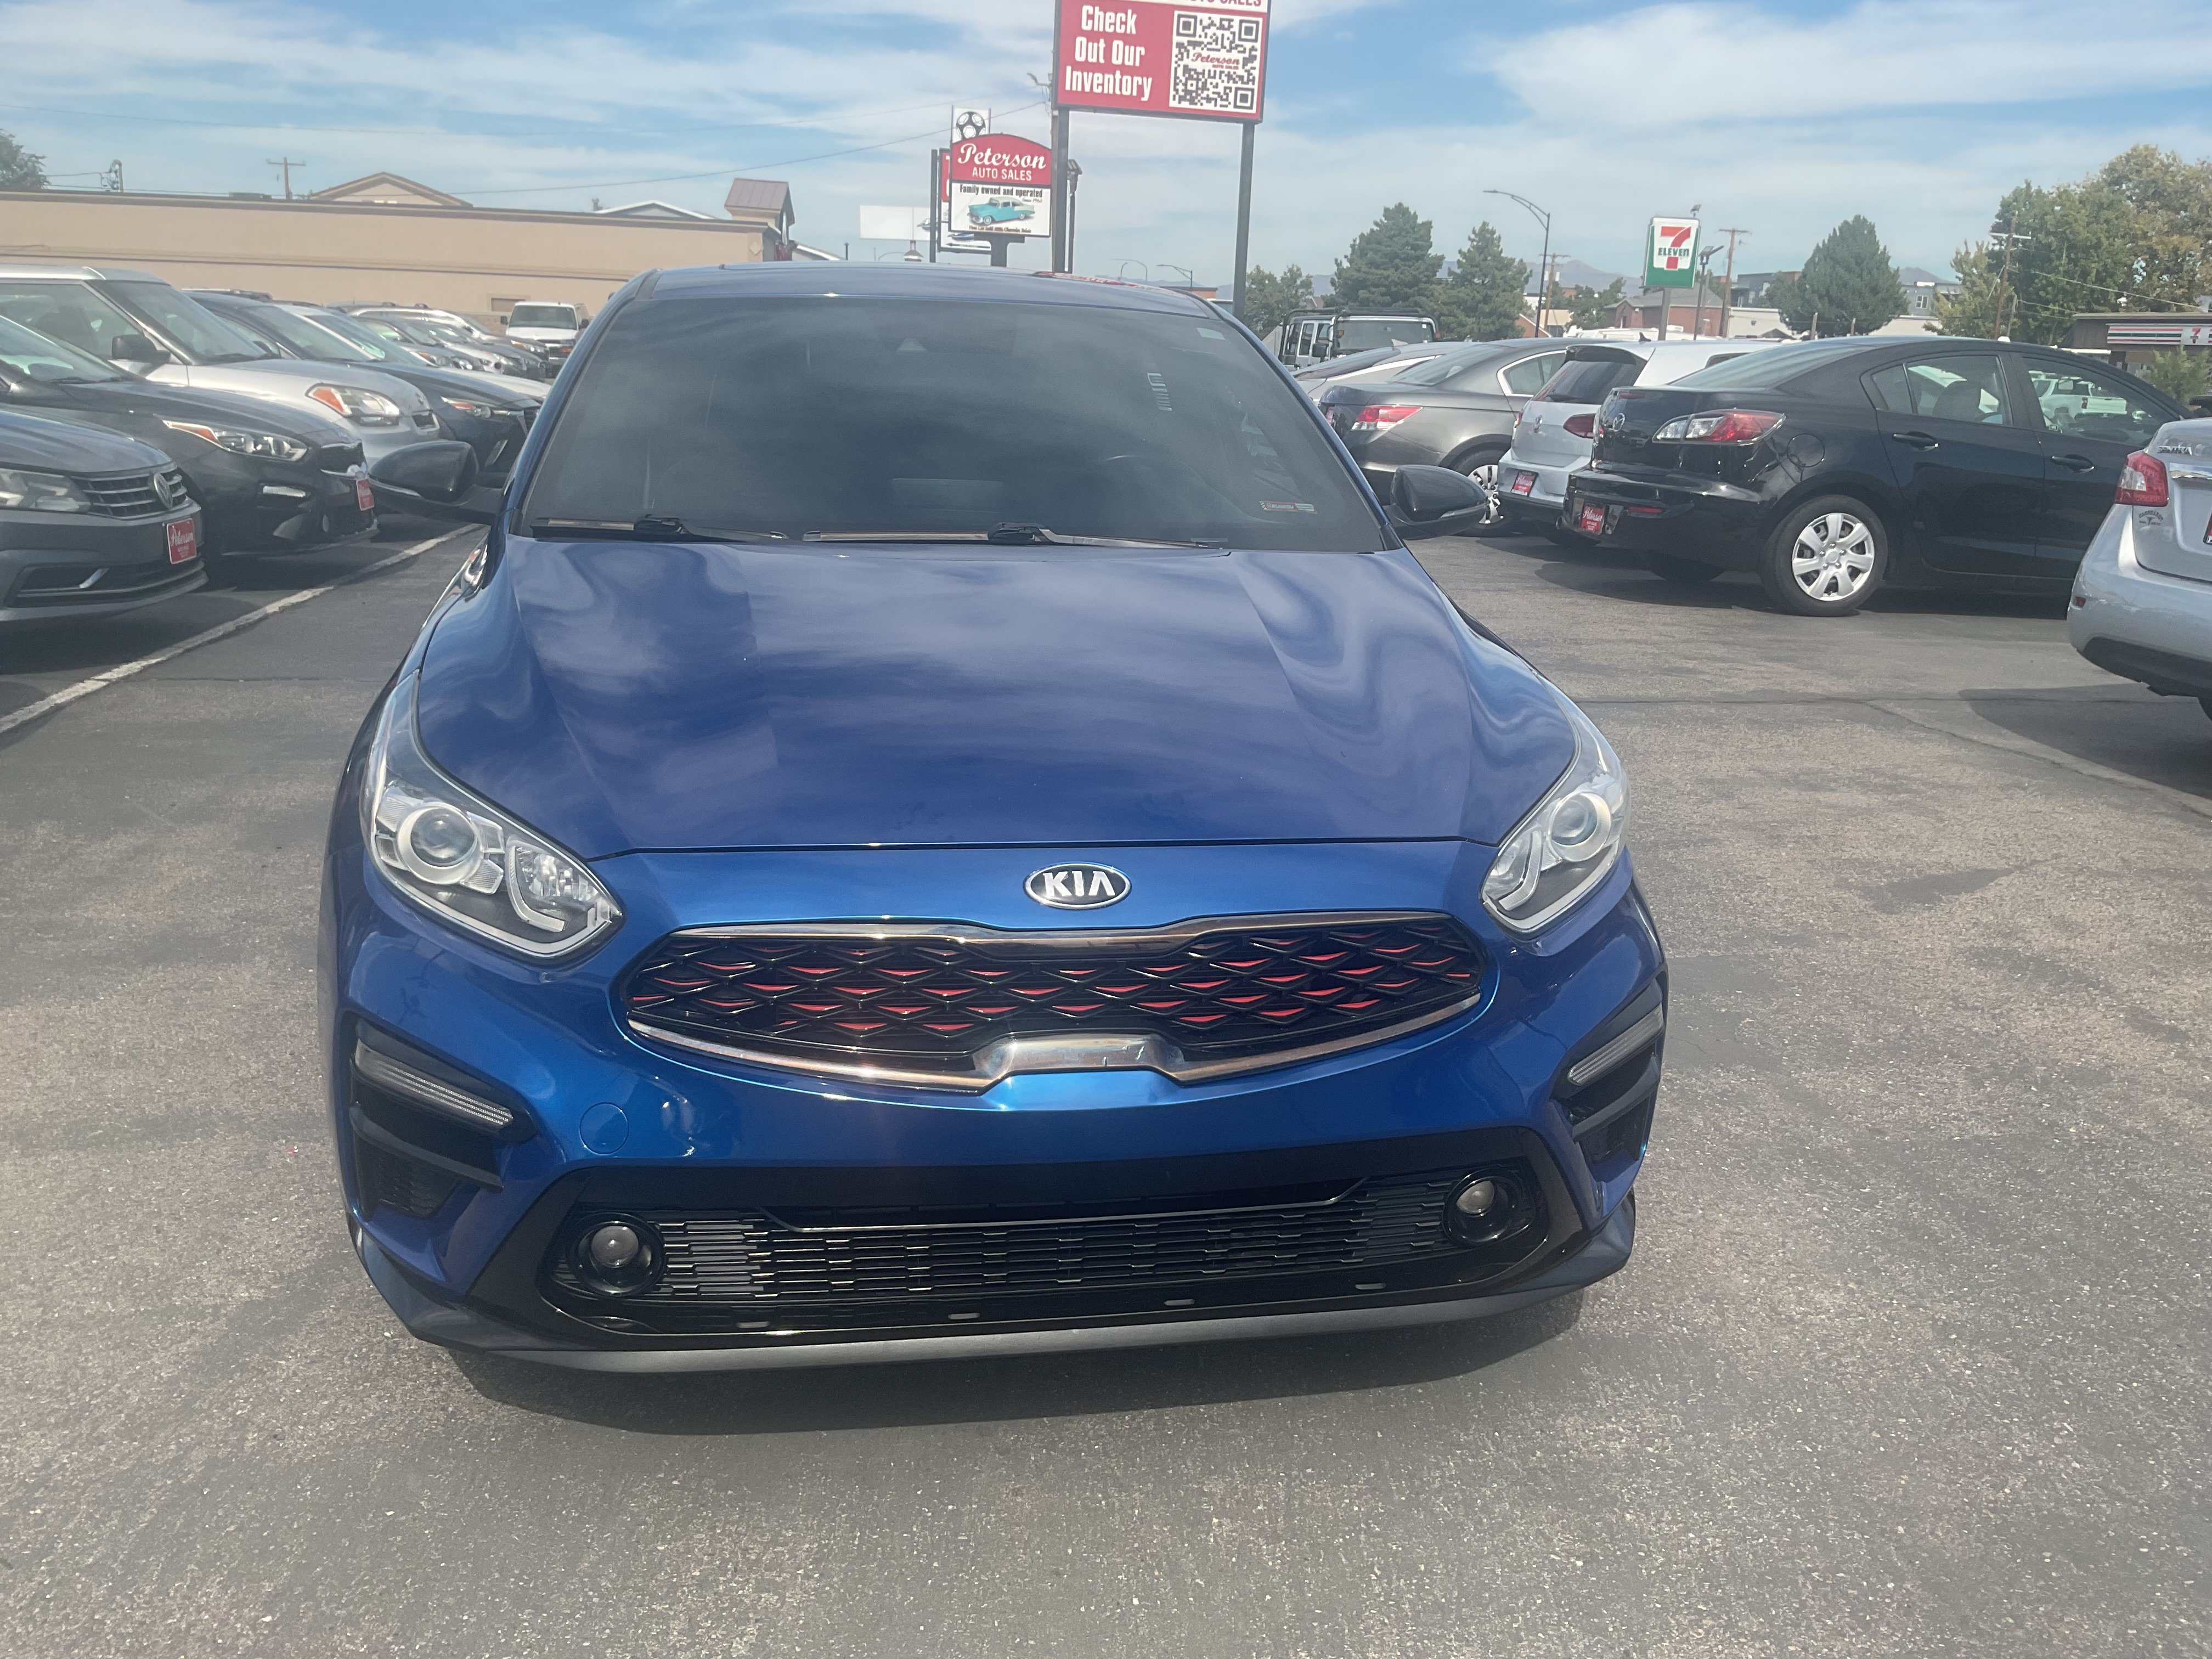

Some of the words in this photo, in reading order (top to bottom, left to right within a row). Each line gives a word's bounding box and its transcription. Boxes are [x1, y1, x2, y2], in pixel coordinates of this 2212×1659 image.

[1081, 5, 1137, 34] Check
[1075, 36, 1105, 64] Out
[1111, 40, 1146, 66] Our
[1191, 52, 1240, 65] Peterson
[1065, 66, 1153, 101] Inventory
[958, 143, 1046, 169] Peterson
[972, 167, 998, 179] AUTO
[1001, 169, 1032, 181] SALES
[960, 184, 979, 195] Family
[981, 185, 1001, 195] owned
[1003, 187, 1013, 196] and
[1015, 189, 1043, 198] operated
[1661, 226, 1691, 269] 7
[1043, 871, 1116, 897] KIA
